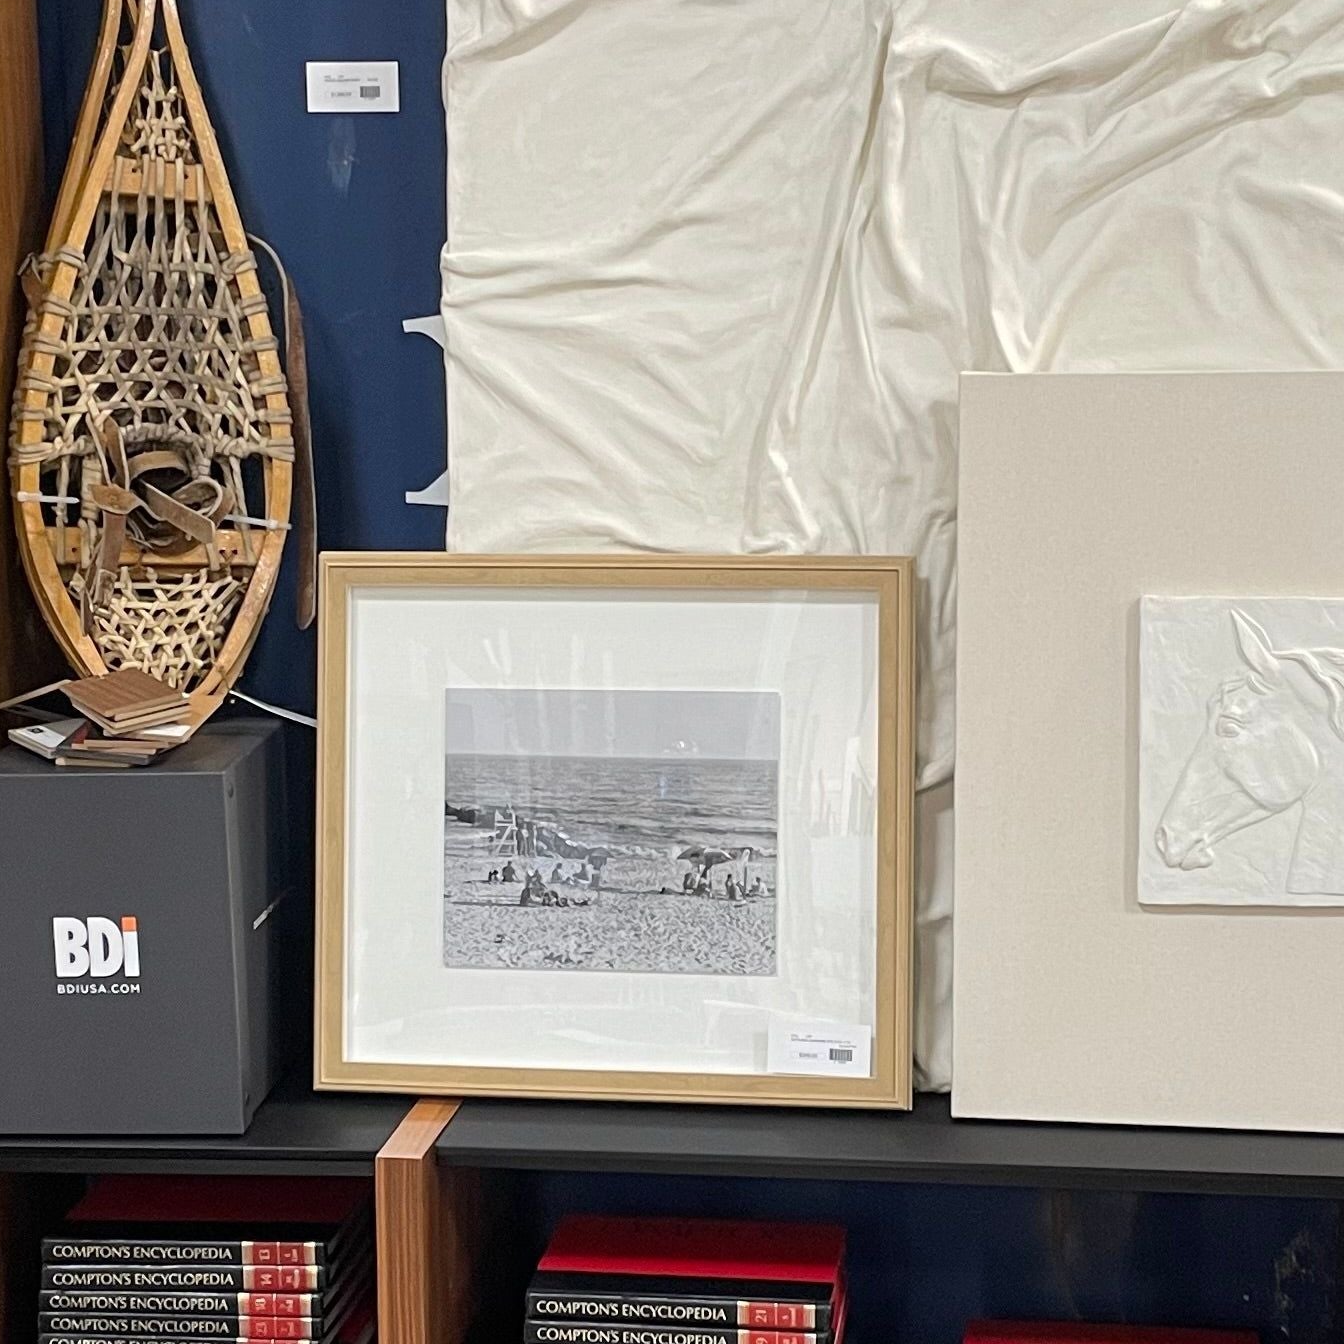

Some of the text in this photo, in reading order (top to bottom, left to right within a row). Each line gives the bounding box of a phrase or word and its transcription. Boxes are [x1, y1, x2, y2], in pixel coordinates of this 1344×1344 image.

[57, 983, 141, 994] BDIUSA.COM
[52, 1245, 232, 1260] COMPTON'S ENCYCLOPEDIA
[52, 1272, 235, 1287] COMPTON'S ENCYCLOPEDIA
[49, 1295, 228, 1311] COMPTON'S ENCYCLOPEDIA
[536, 1299, 727, 1322] COMPTON'S ENCYCLOPEDIA
[755, 1309, 767, 1323] 21
[50, 1317, 229, 1334] COMPTON'S ENCYCLOPEDIA
[536, 1327, 619, 1343] COMPTON'S
